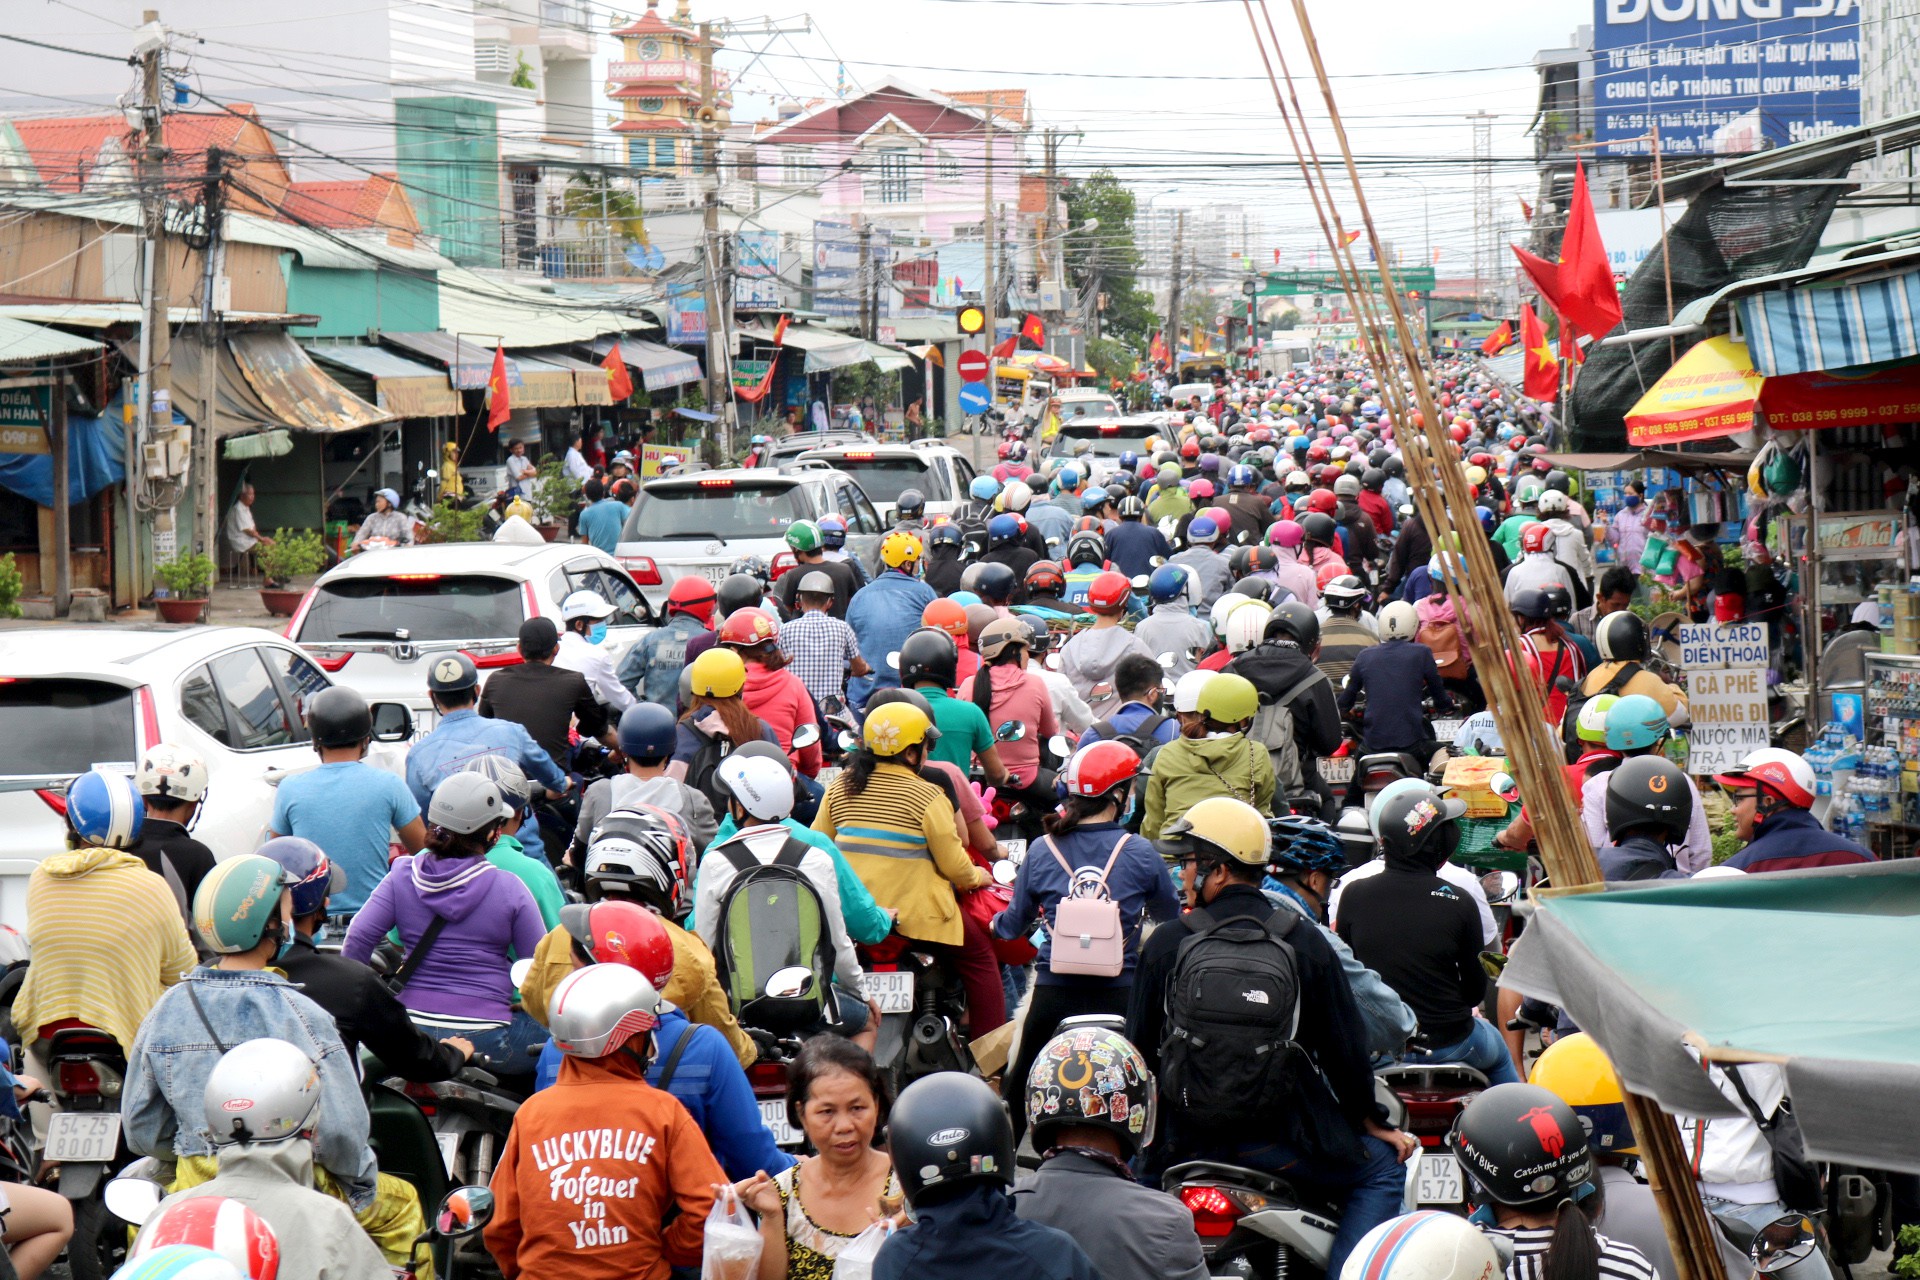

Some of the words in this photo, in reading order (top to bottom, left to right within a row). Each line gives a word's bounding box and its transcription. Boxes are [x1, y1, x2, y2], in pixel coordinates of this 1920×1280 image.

[1765, 39, 1787, 63] ĐẤT
[1605, 81, 1646, 99] CUNG
[1650, 74, 1679, 97] CẤP
[1682, 75, 1732, 96] THÔNG
[1734, 78, 1760, 94] TIN
[1763, 76, 1791, 95] QUY
[1793, 74, 1840, 95] HOẠCH
[1632, 427, 1646, 437] ĐT:
[1648, 425, 1662, 435] 038
[1664, 423, 1678, 433] 596
[1679, 420, 1698, 431] 9999
[1704, 416, 1718, 427] 037
[1721, 414, 1735, 425] 556
[1736, 411, 1754, 422] 9999
[1769, 413, 1789, 424] ĐT:
[1792, 412, 1813, 423] 038
[1816, 410, 1837, 421] 596
[1840, 407, 1868, 419] 9999
[1878, 405, 1900, 416] 037
[1680, 624, 1711, 645] BÁN
[1696, 672, 1719, 696] CÀ
[1725, 670, 1759, 695] PHÊ
[1690, 704, 1744, 724] MANG
[1749, 703, 1767, 723] ĐI
[1692, 724, 1737, 747] NƯỚC
[1742, 723, 1767, 746] MÍA
[1691, 747, 1726, 766] TRÀ
[1323, 770, 1350, 781] 2444
[1699, 766, 1716, 775] 5K
[1430, 890, 1460, 901] EVEREST
[865, 975, 903, 992] 59-D1
[60, 1117, 110, 1136] 54-Z5
[930, 1129, 968, 1143] Andes
[56, 1138, 104, 1157] 8001
[531, 1128, 657, 1172] LUCKYBLUE
[1465, 1143, 1479, 1161] MY
[1479, 1155, 1499, 1177] BIKE
[1513, 1164, 1543, 1179] Catch
[1544, 1161, 1557, 1171] me
[1559, 1157, 1565, 1166] if
[1567, 1151, 1579, 1164] you
[1422, 1179, 1459, 1200] 5.72
[583, 1197, 606, 1219] in
[568, 1219, 629, 1250] Yohn
